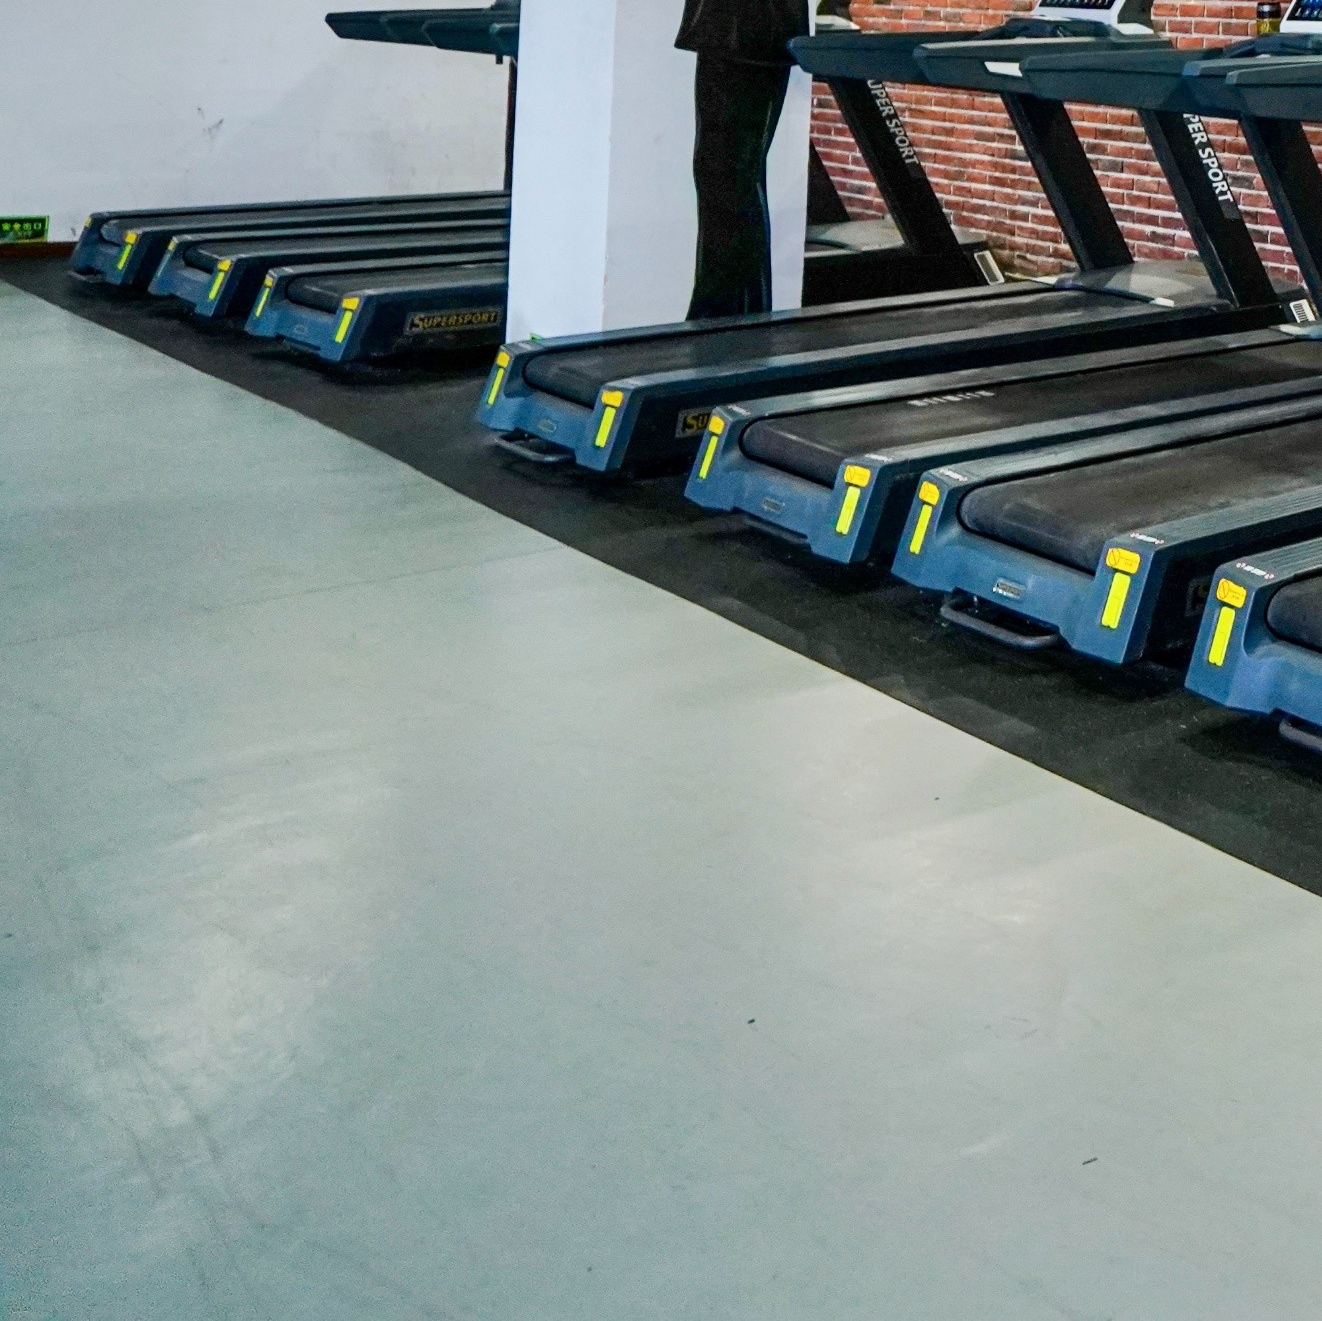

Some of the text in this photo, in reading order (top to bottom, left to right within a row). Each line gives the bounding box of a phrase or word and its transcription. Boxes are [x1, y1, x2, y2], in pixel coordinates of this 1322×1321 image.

[867, 80, 919, 165] UPER SPORT
[1183, 113, 1234, 203] PER SPORT
